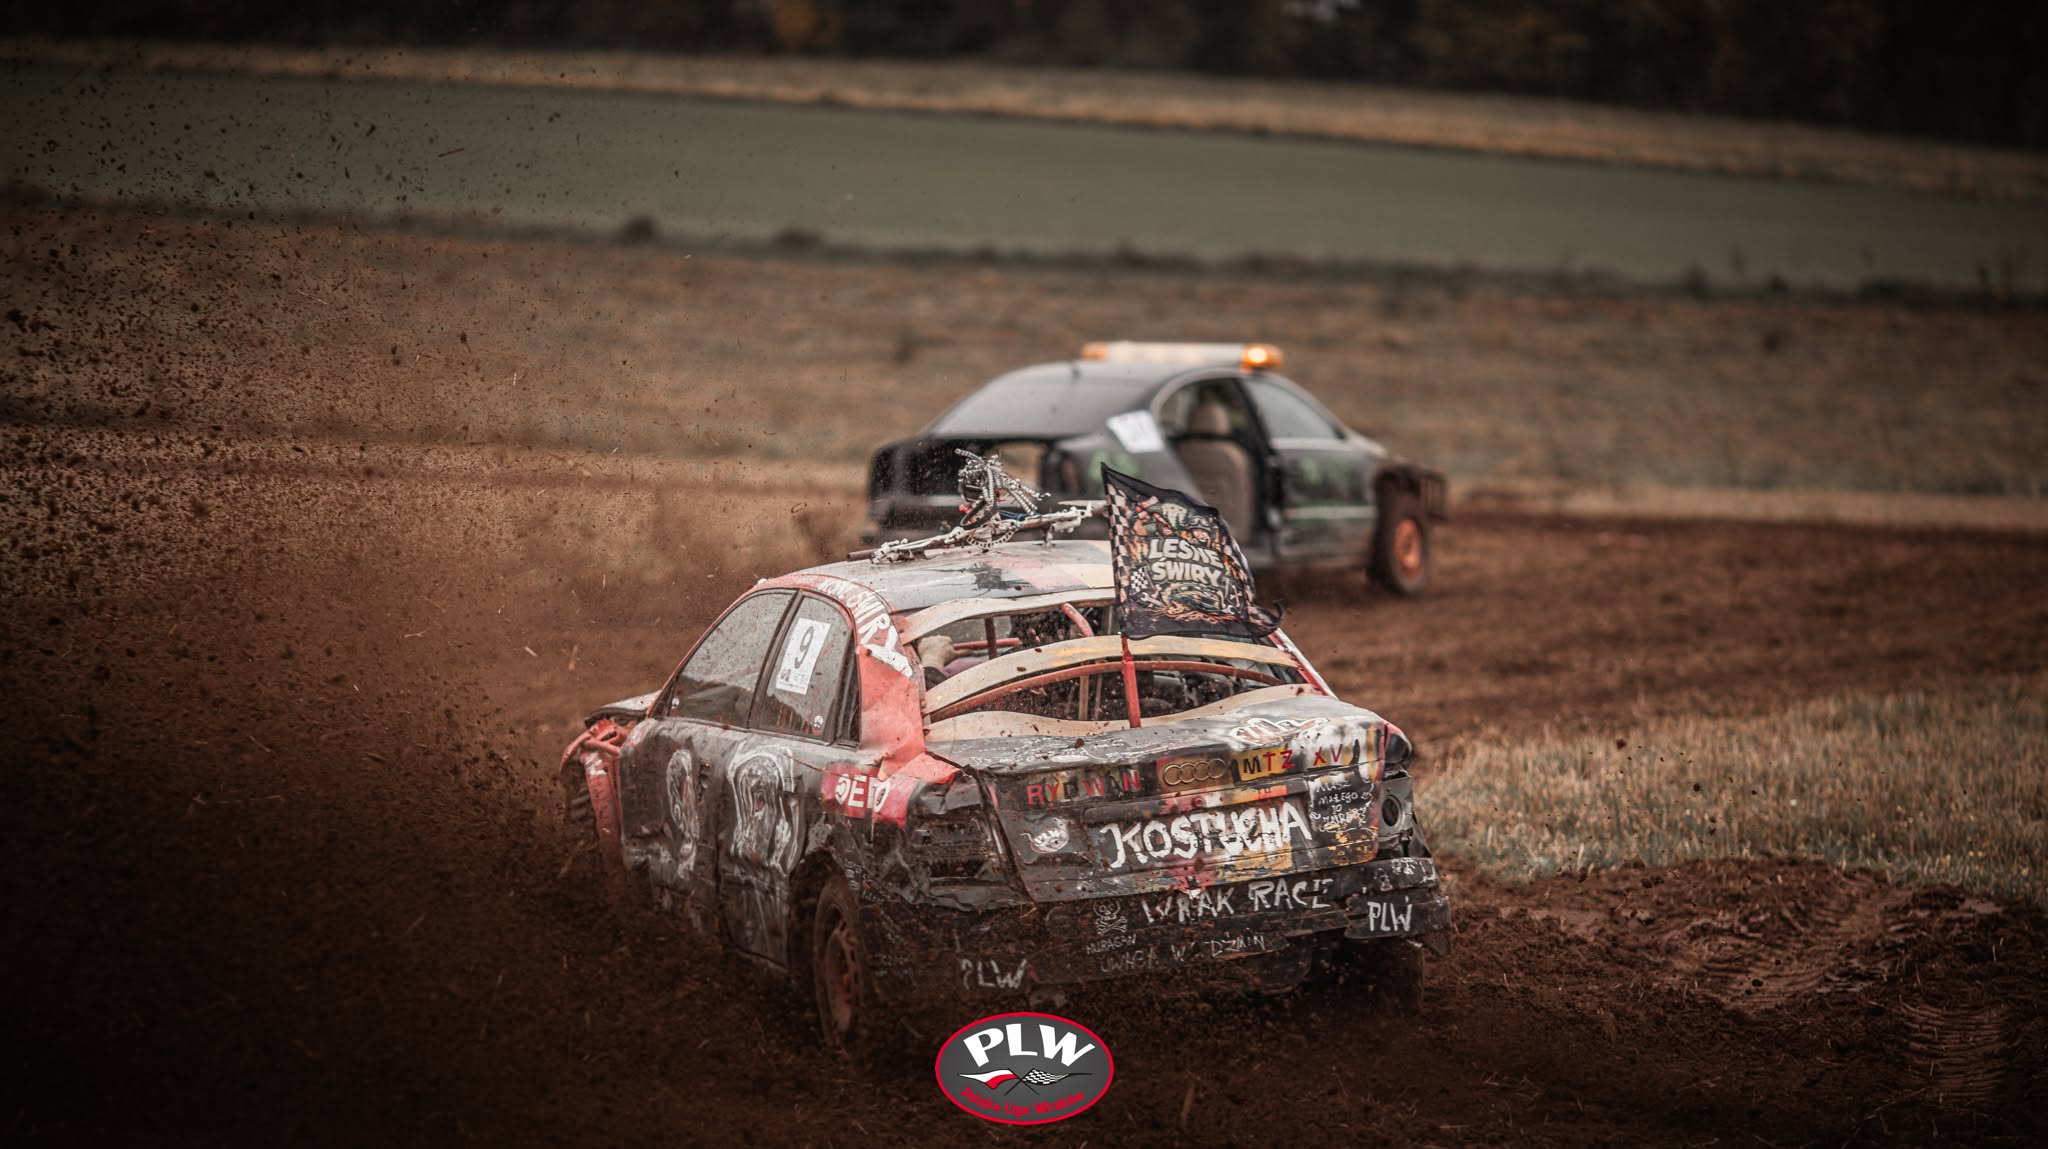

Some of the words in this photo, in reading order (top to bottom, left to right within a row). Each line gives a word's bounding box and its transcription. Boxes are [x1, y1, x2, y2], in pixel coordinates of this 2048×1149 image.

[1151, 557, 1222, 587] ŚWIRY
[794, 626, 814, 669] 9
[1026, 769, 1142, 805] RYDWAN
[1243, 749, 1295, 774] MTZ
[1100, 802, 1312, 868] KOSTUCHA
[1141, 887, 1235, 924] WRAK
[1248, 877, 1334, 913] RACE
[1367, 901, 1413, 932] PLW
[959, 958, 1029, 991] PLW
